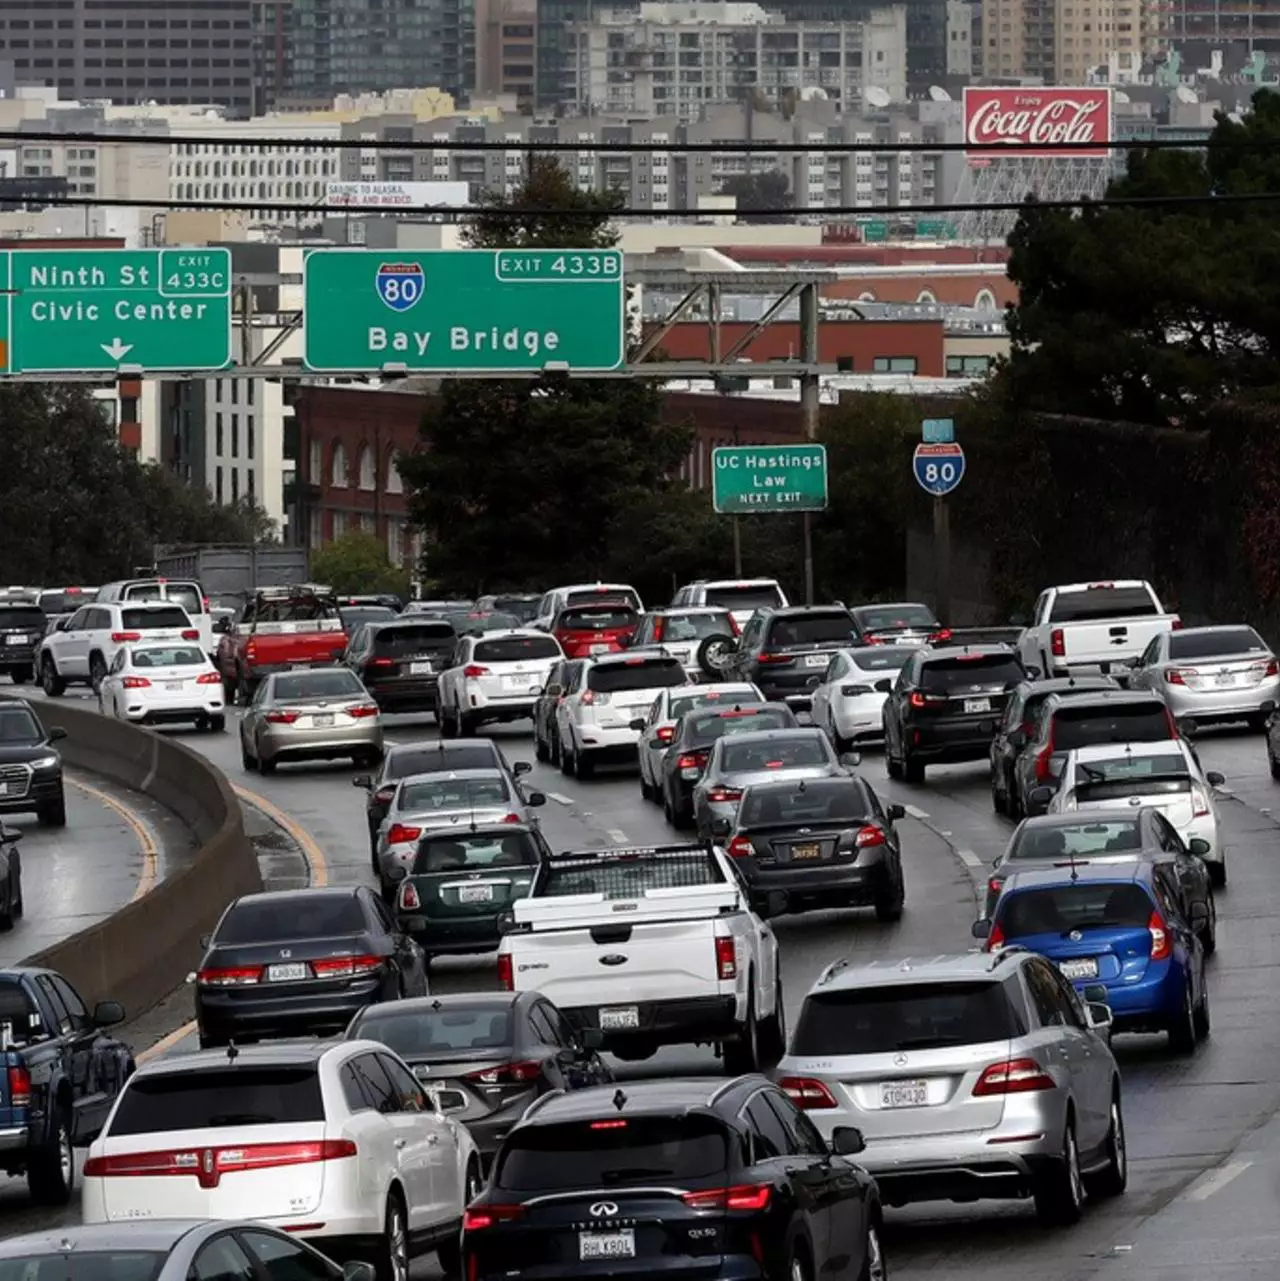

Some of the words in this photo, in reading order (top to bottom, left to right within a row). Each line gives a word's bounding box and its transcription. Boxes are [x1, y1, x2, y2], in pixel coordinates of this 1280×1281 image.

[968, 99, 1104, 144] Coca-Cola
[360, 185, 371, 194] TO
[362, 195, 380, 205] AND
[178, 255, 211, 267] EXIT
[500, 258, 542, 272] EXIT
[550, 256, 619, 275] 433B
[30, 266, 106, 286] Ninth
[120, 265, 150, 286] St
[167, 272, 224, 289] 433C
[383, 278, 418, 302] 80
[31, 300, 100, 321] Civic
[114, 300, 208, 320] Center
[368, 326, 431, 356] Bay
[450, 326, 561, 356] Bridge
[716, 455, 740, 470] UC
[745, 454, 822, 471] Hastings
[753, 475, 787, 487] Law
[925, 463, 956, 483] 80
[740, 493, 770, 504] NEXT
[776, 492, 802, 503] EXIT
